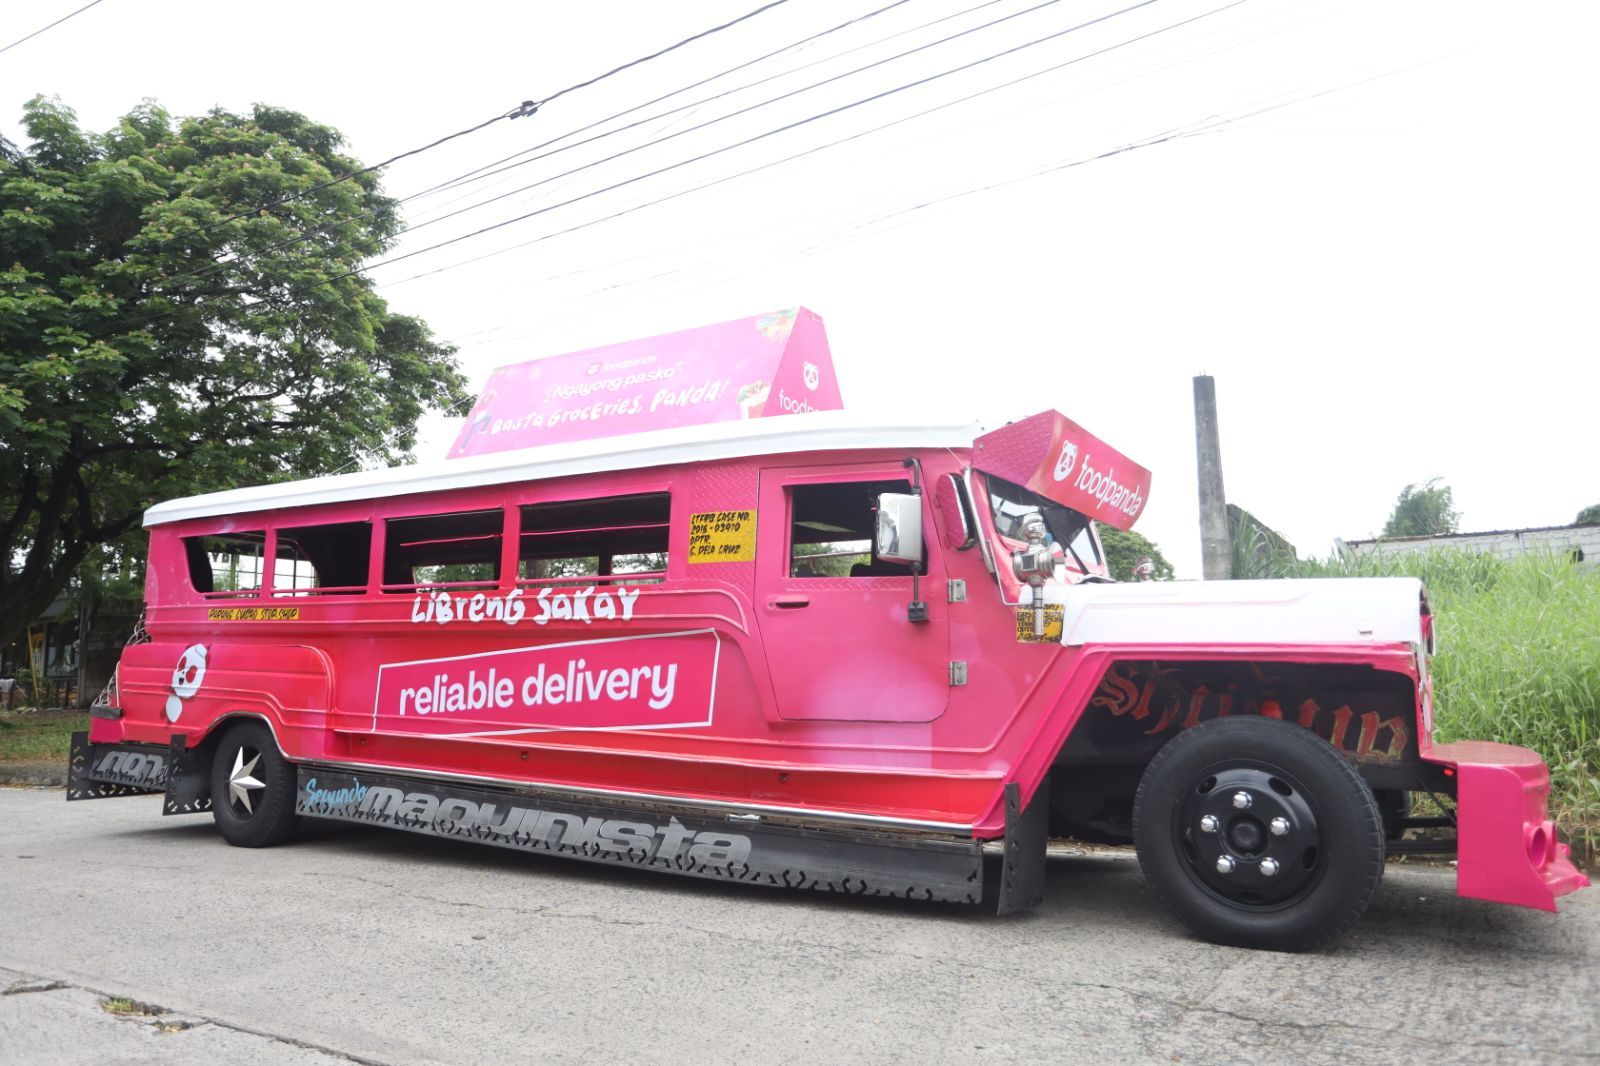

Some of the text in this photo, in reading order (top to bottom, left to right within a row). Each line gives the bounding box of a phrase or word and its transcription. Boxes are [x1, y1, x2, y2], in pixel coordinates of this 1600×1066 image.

[552, 367, 675, 399] Ngayong pasko
[1074, 454, 1142, 516] foodpanda
[717, 512, 736, 522] CASE
[690, 524, 708, 535] 2016
[718, 544, 741, 555] CRUZ
[399, 658, 678, 716] reliable delivery
